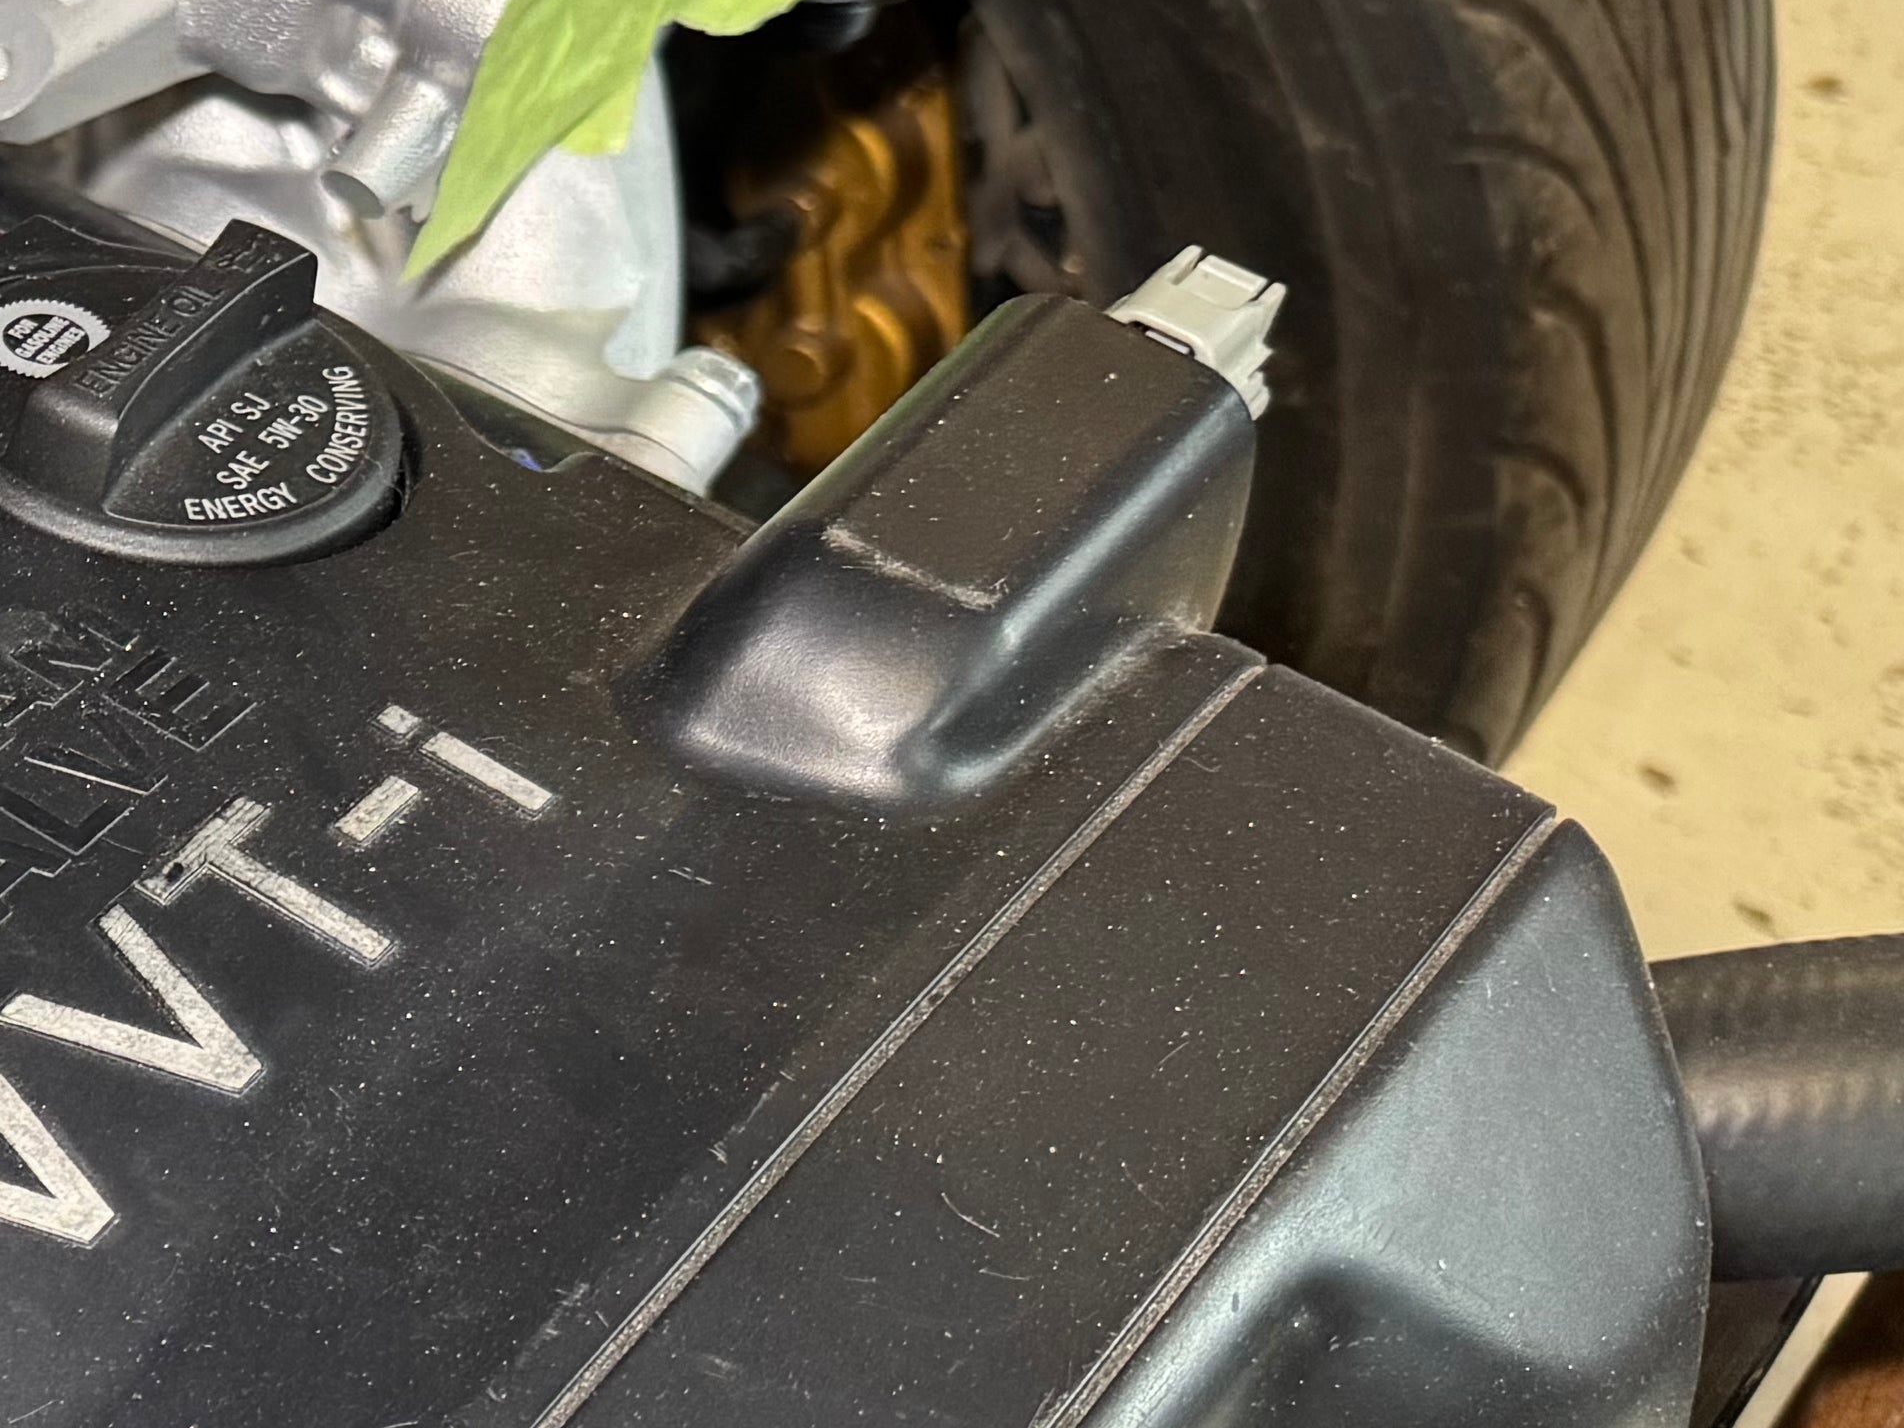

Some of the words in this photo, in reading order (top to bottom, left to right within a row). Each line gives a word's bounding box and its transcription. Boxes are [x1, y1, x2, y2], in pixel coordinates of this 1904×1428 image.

[7, 318, 39, 340] FOR
[14, 316, 70, 359] GASOLINE
[35, 326, 86, 365] ENGINES
[74, 321, 185, 396] ENGINE
[172, 284, 225, 318] OIL
[184, 481, 297, 521] ENERGY
[305, 365, 369, 484] CONSERVING
[197, 418, 244, 454] API
[230, 392, 271, 421] SJ
[216, 450, 270, 490] SAE
[257, 394, 329, 450] 5W-30
